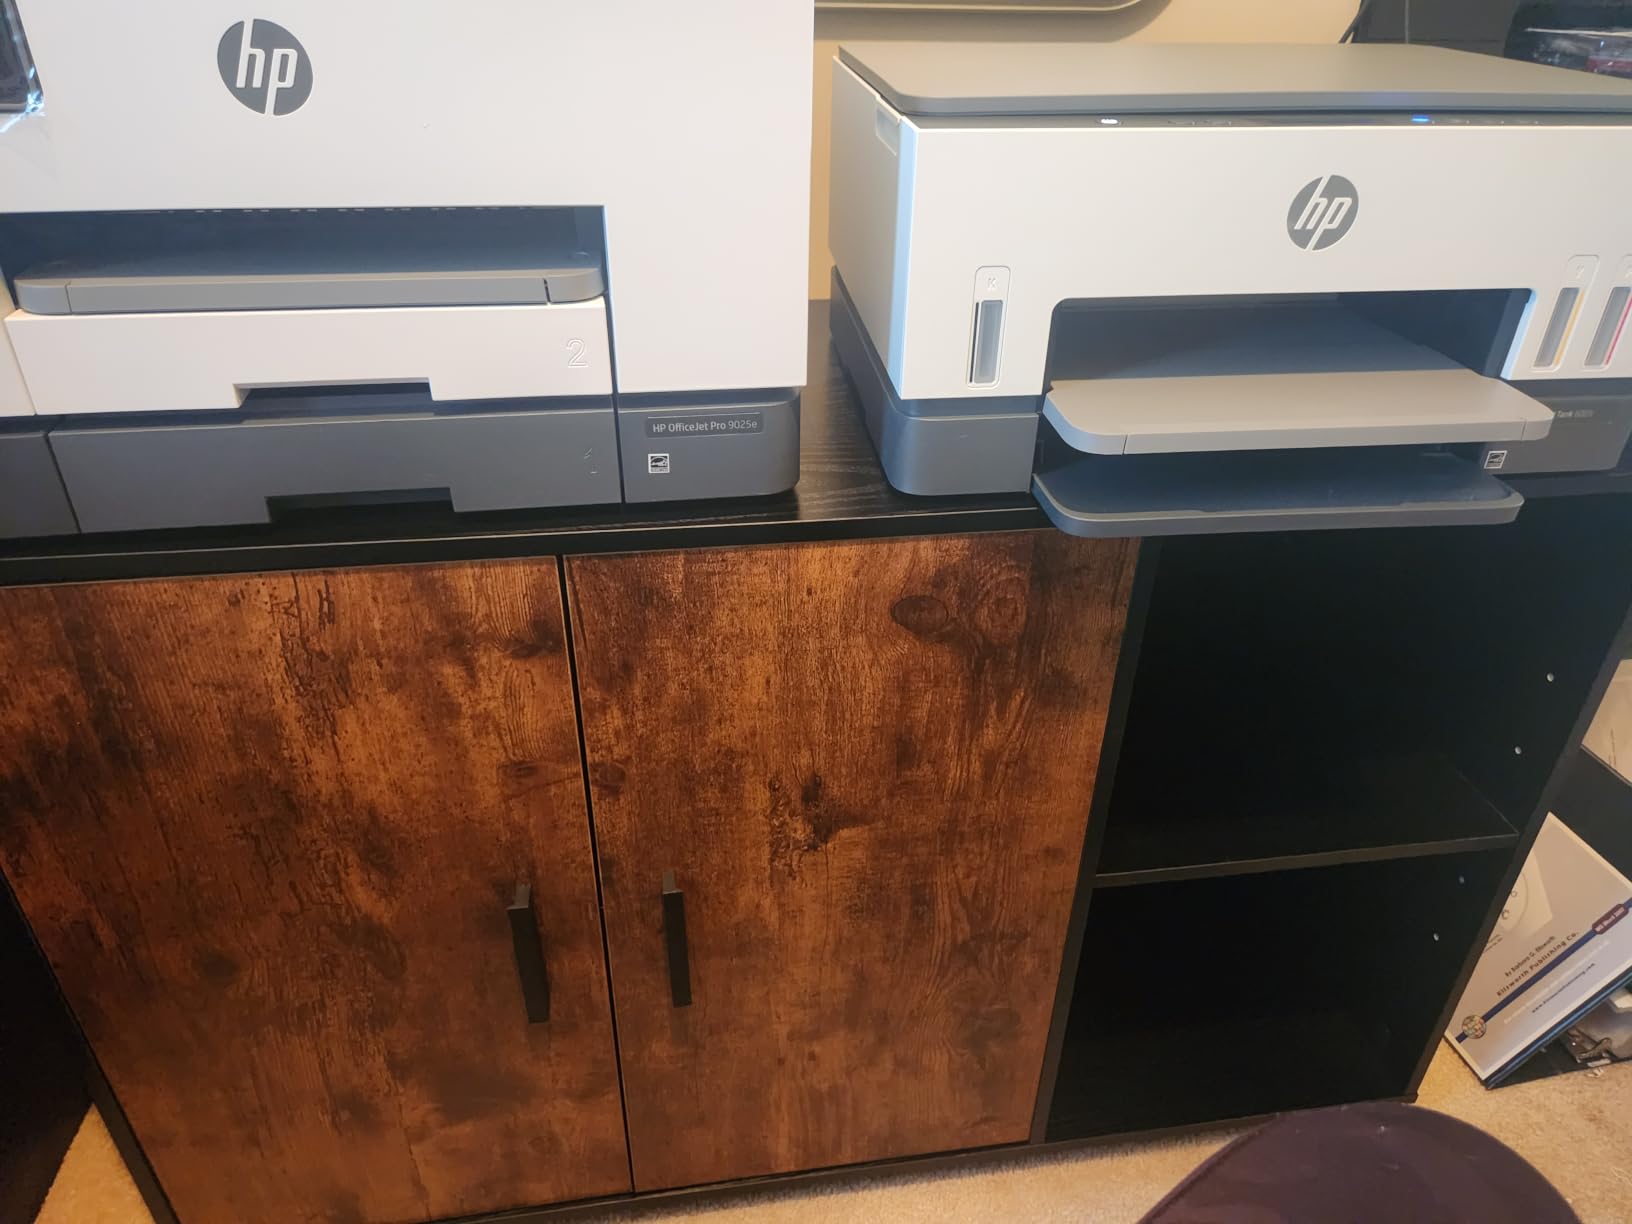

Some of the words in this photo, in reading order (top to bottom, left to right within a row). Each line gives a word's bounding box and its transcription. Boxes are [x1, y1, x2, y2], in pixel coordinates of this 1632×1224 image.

[236, 19, 298, 117] hp
[1294, 175, 1353, 252] hp
[566, 338, 589, 369] 2
[652, 423, 666, 433] HP
[668, 421, 709, 433] OfficeJet
[710, 420, 727, 431] Pro
[728, 419, 758, 430] 9025e
[1529, 941, 1567, 971] Publishing
